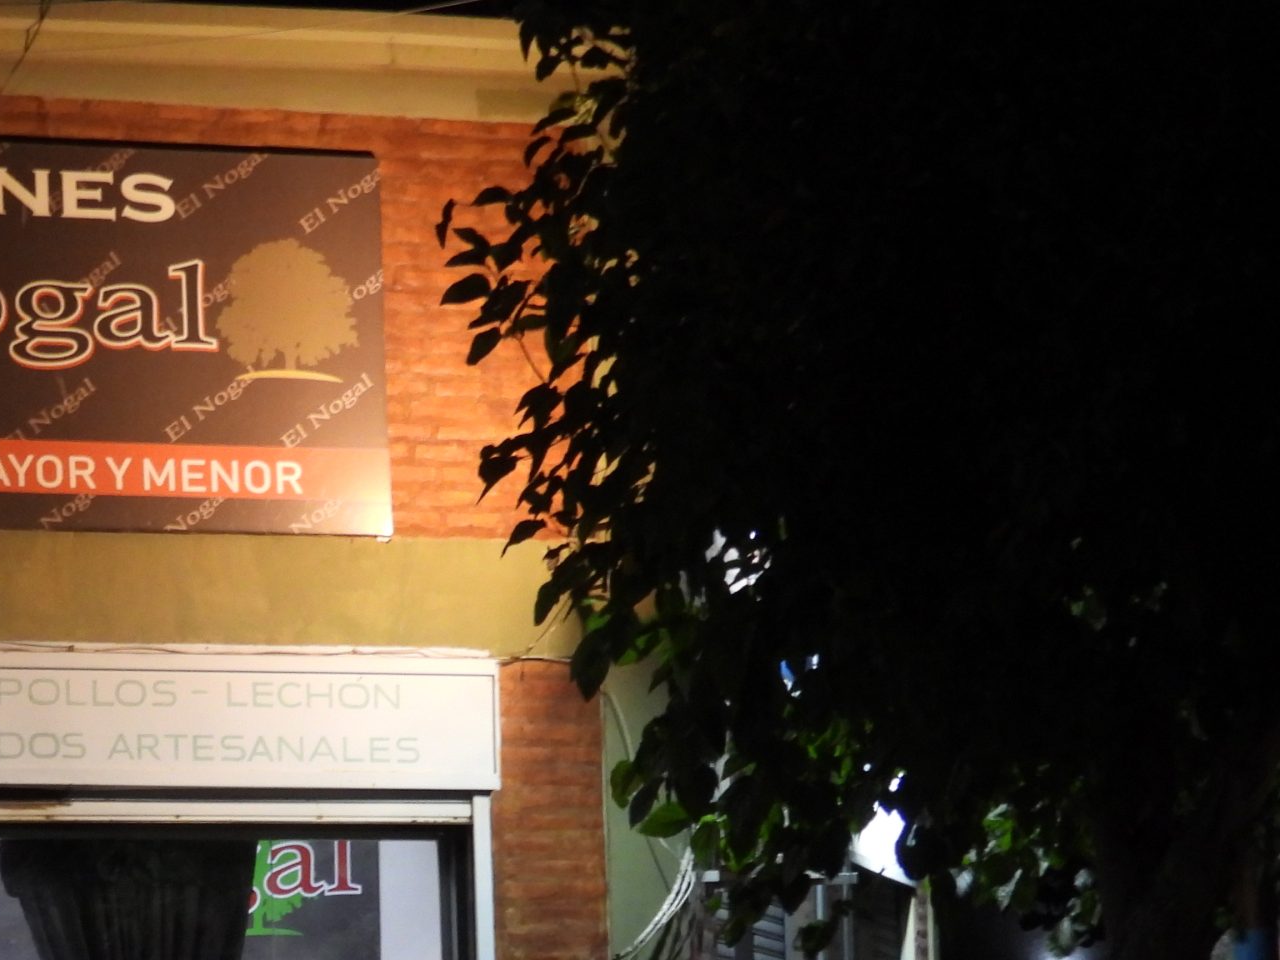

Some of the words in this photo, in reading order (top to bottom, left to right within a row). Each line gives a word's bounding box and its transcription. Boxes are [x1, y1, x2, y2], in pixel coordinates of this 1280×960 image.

[27, 377, 98, 434] Nogal
[280, 423, 309, 448] El
[306, 372, 375, 430] Nogal
[164, 415, 192, 442] El
[105, 456, 132, 491] Y
[142, 459, 304, 495] MENOR
[108, 733, 421, 764] ARTESANALES
